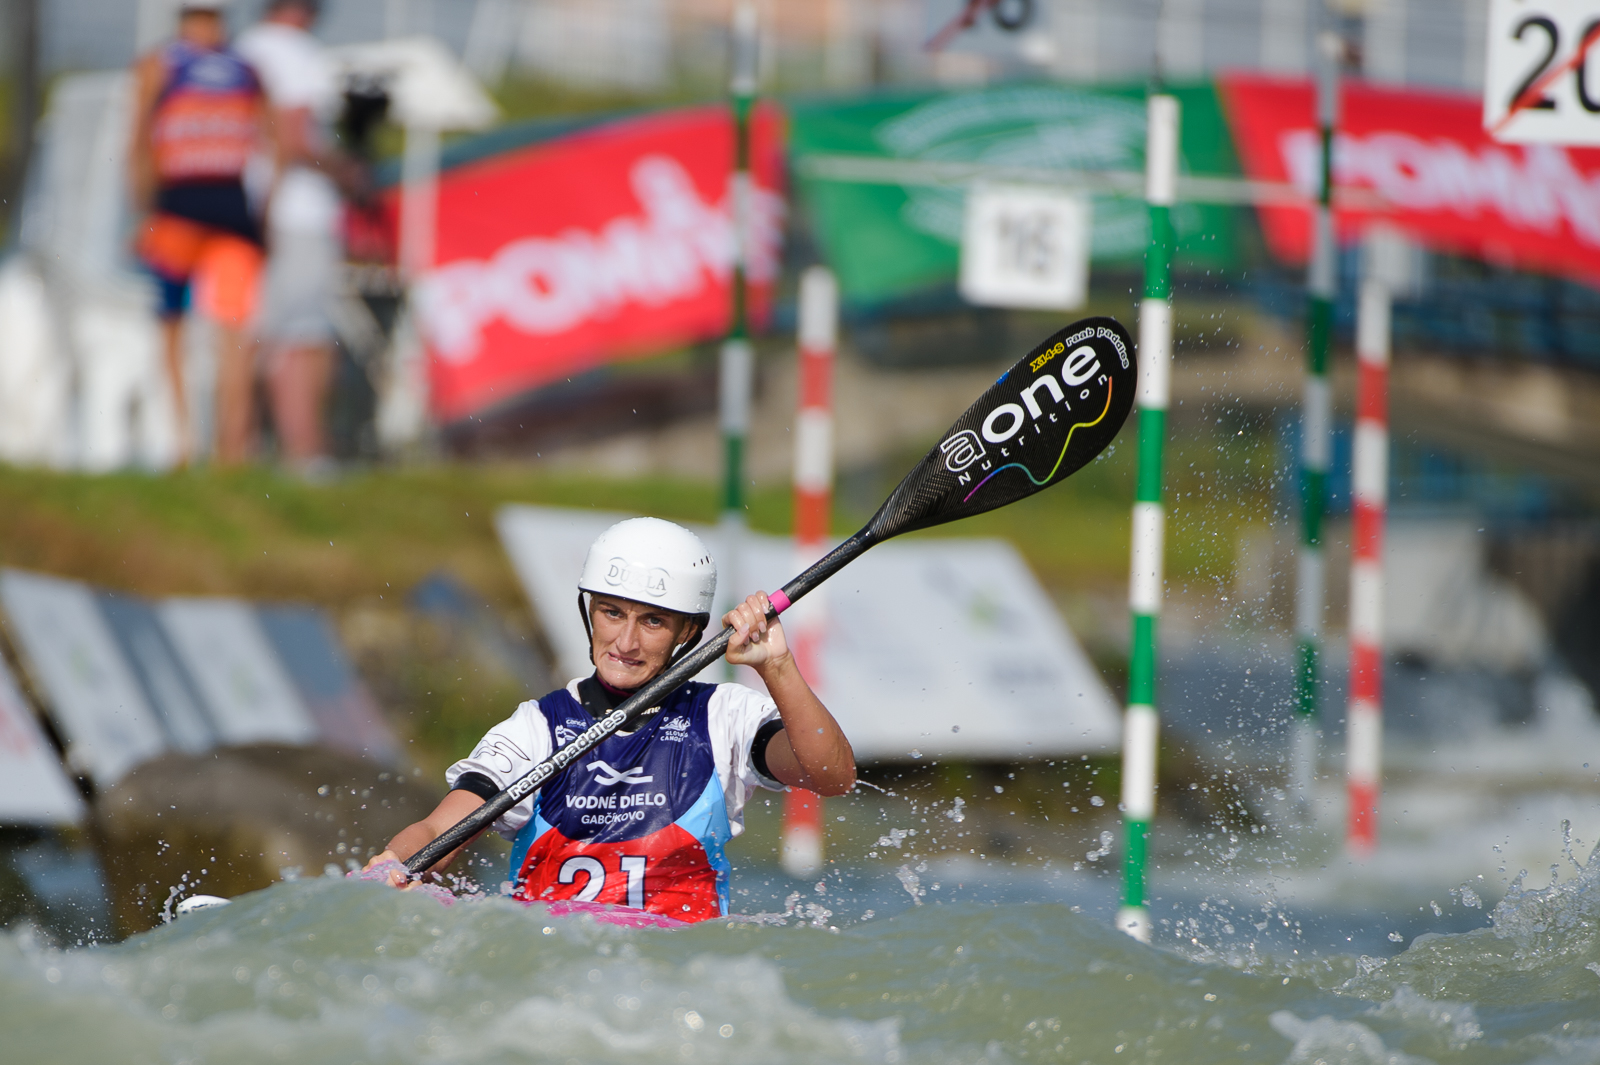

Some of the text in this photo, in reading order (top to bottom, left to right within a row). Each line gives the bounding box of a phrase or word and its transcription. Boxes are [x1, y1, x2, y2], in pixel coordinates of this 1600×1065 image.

[1029, 326, 1130, 373] X14-S raab paddles
[507, 709, 627, 801] raab paddles
[565, 792, 667, 810] VODNÉ DIELO
[558, 854, 648, 911] 21
